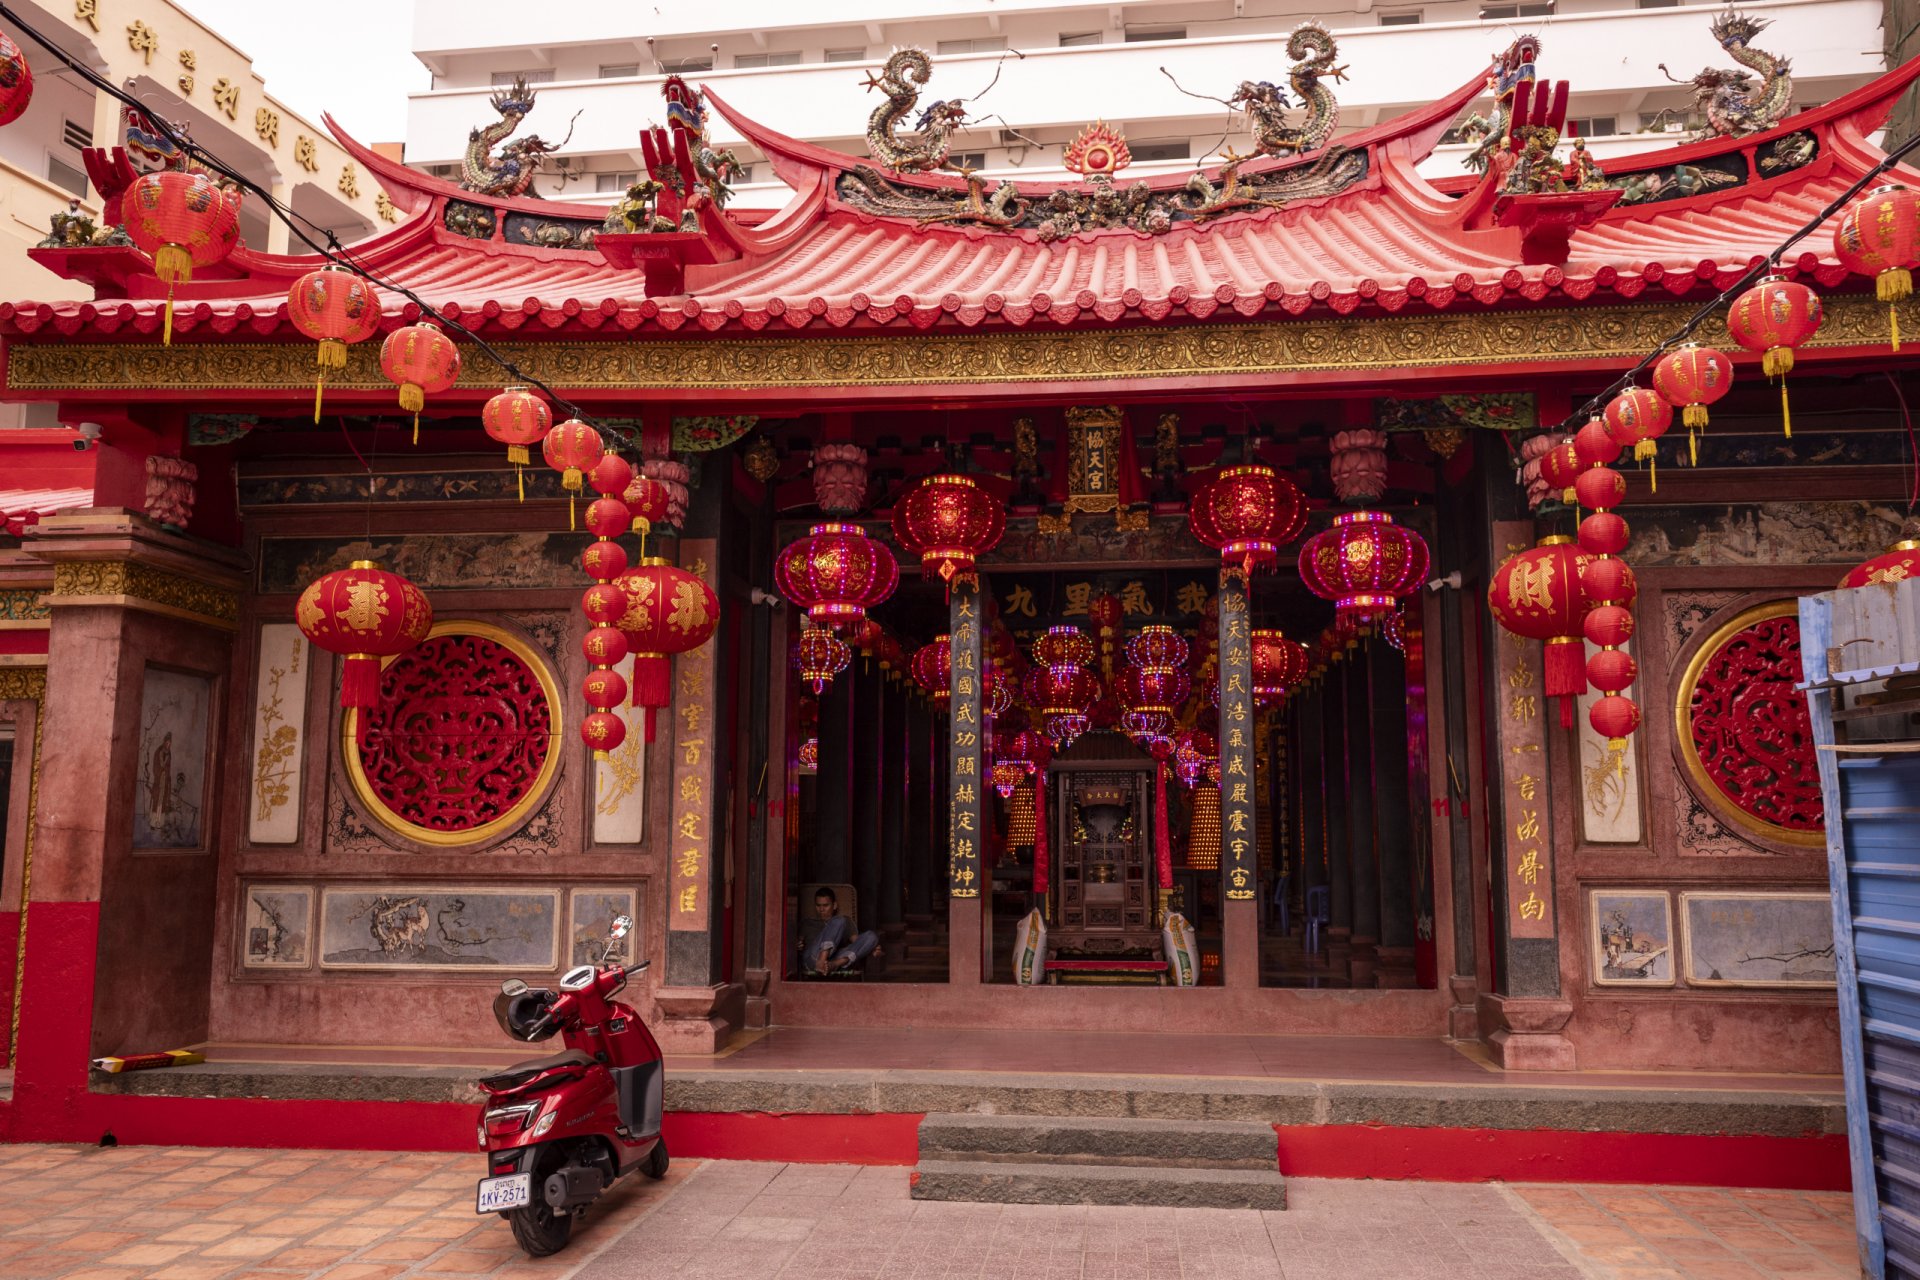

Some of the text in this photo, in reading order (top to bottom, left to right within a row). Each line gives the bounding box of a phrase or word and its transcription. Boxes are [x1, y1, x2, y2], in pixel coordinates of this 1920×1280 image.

[1087, 431, 1104, 490] 協天宮
[481, 1186, 527, 1206] 1KV-2571
